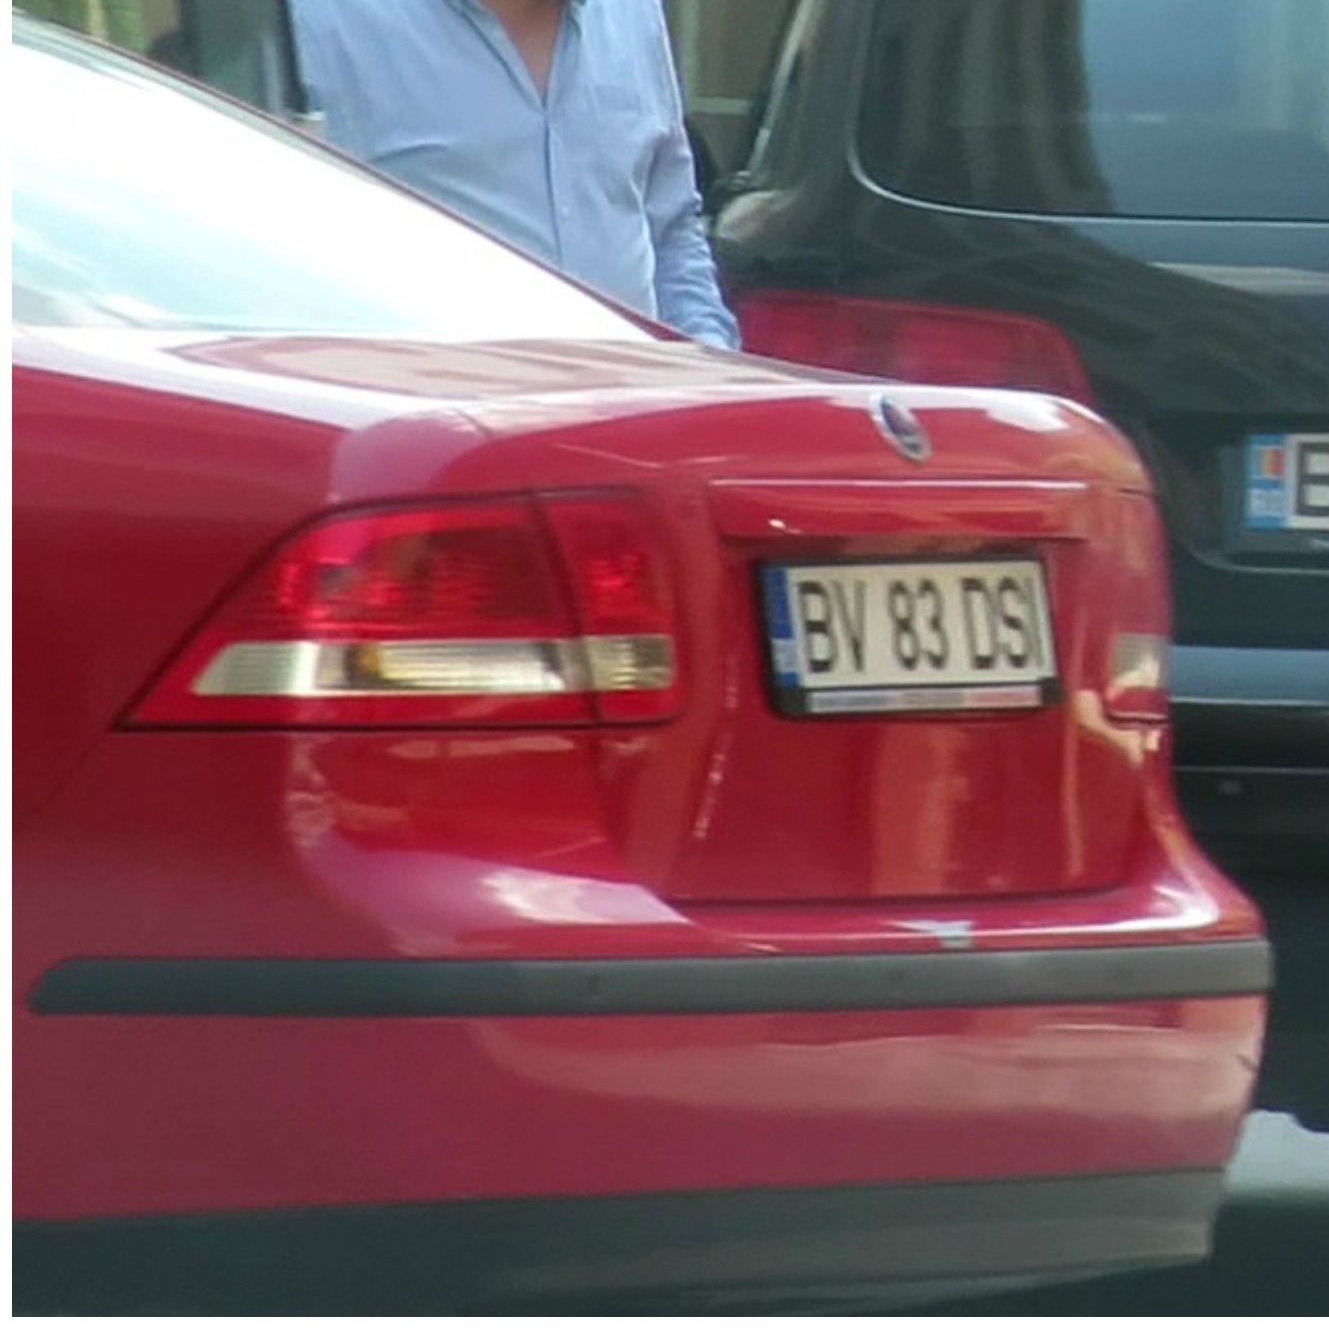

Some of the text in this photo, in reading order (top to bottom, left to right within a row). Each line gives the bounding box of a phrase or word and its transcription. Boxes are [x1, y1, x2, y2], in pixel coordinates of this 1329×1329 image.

[798, 574, 1047, 674] BV 83 DSI
